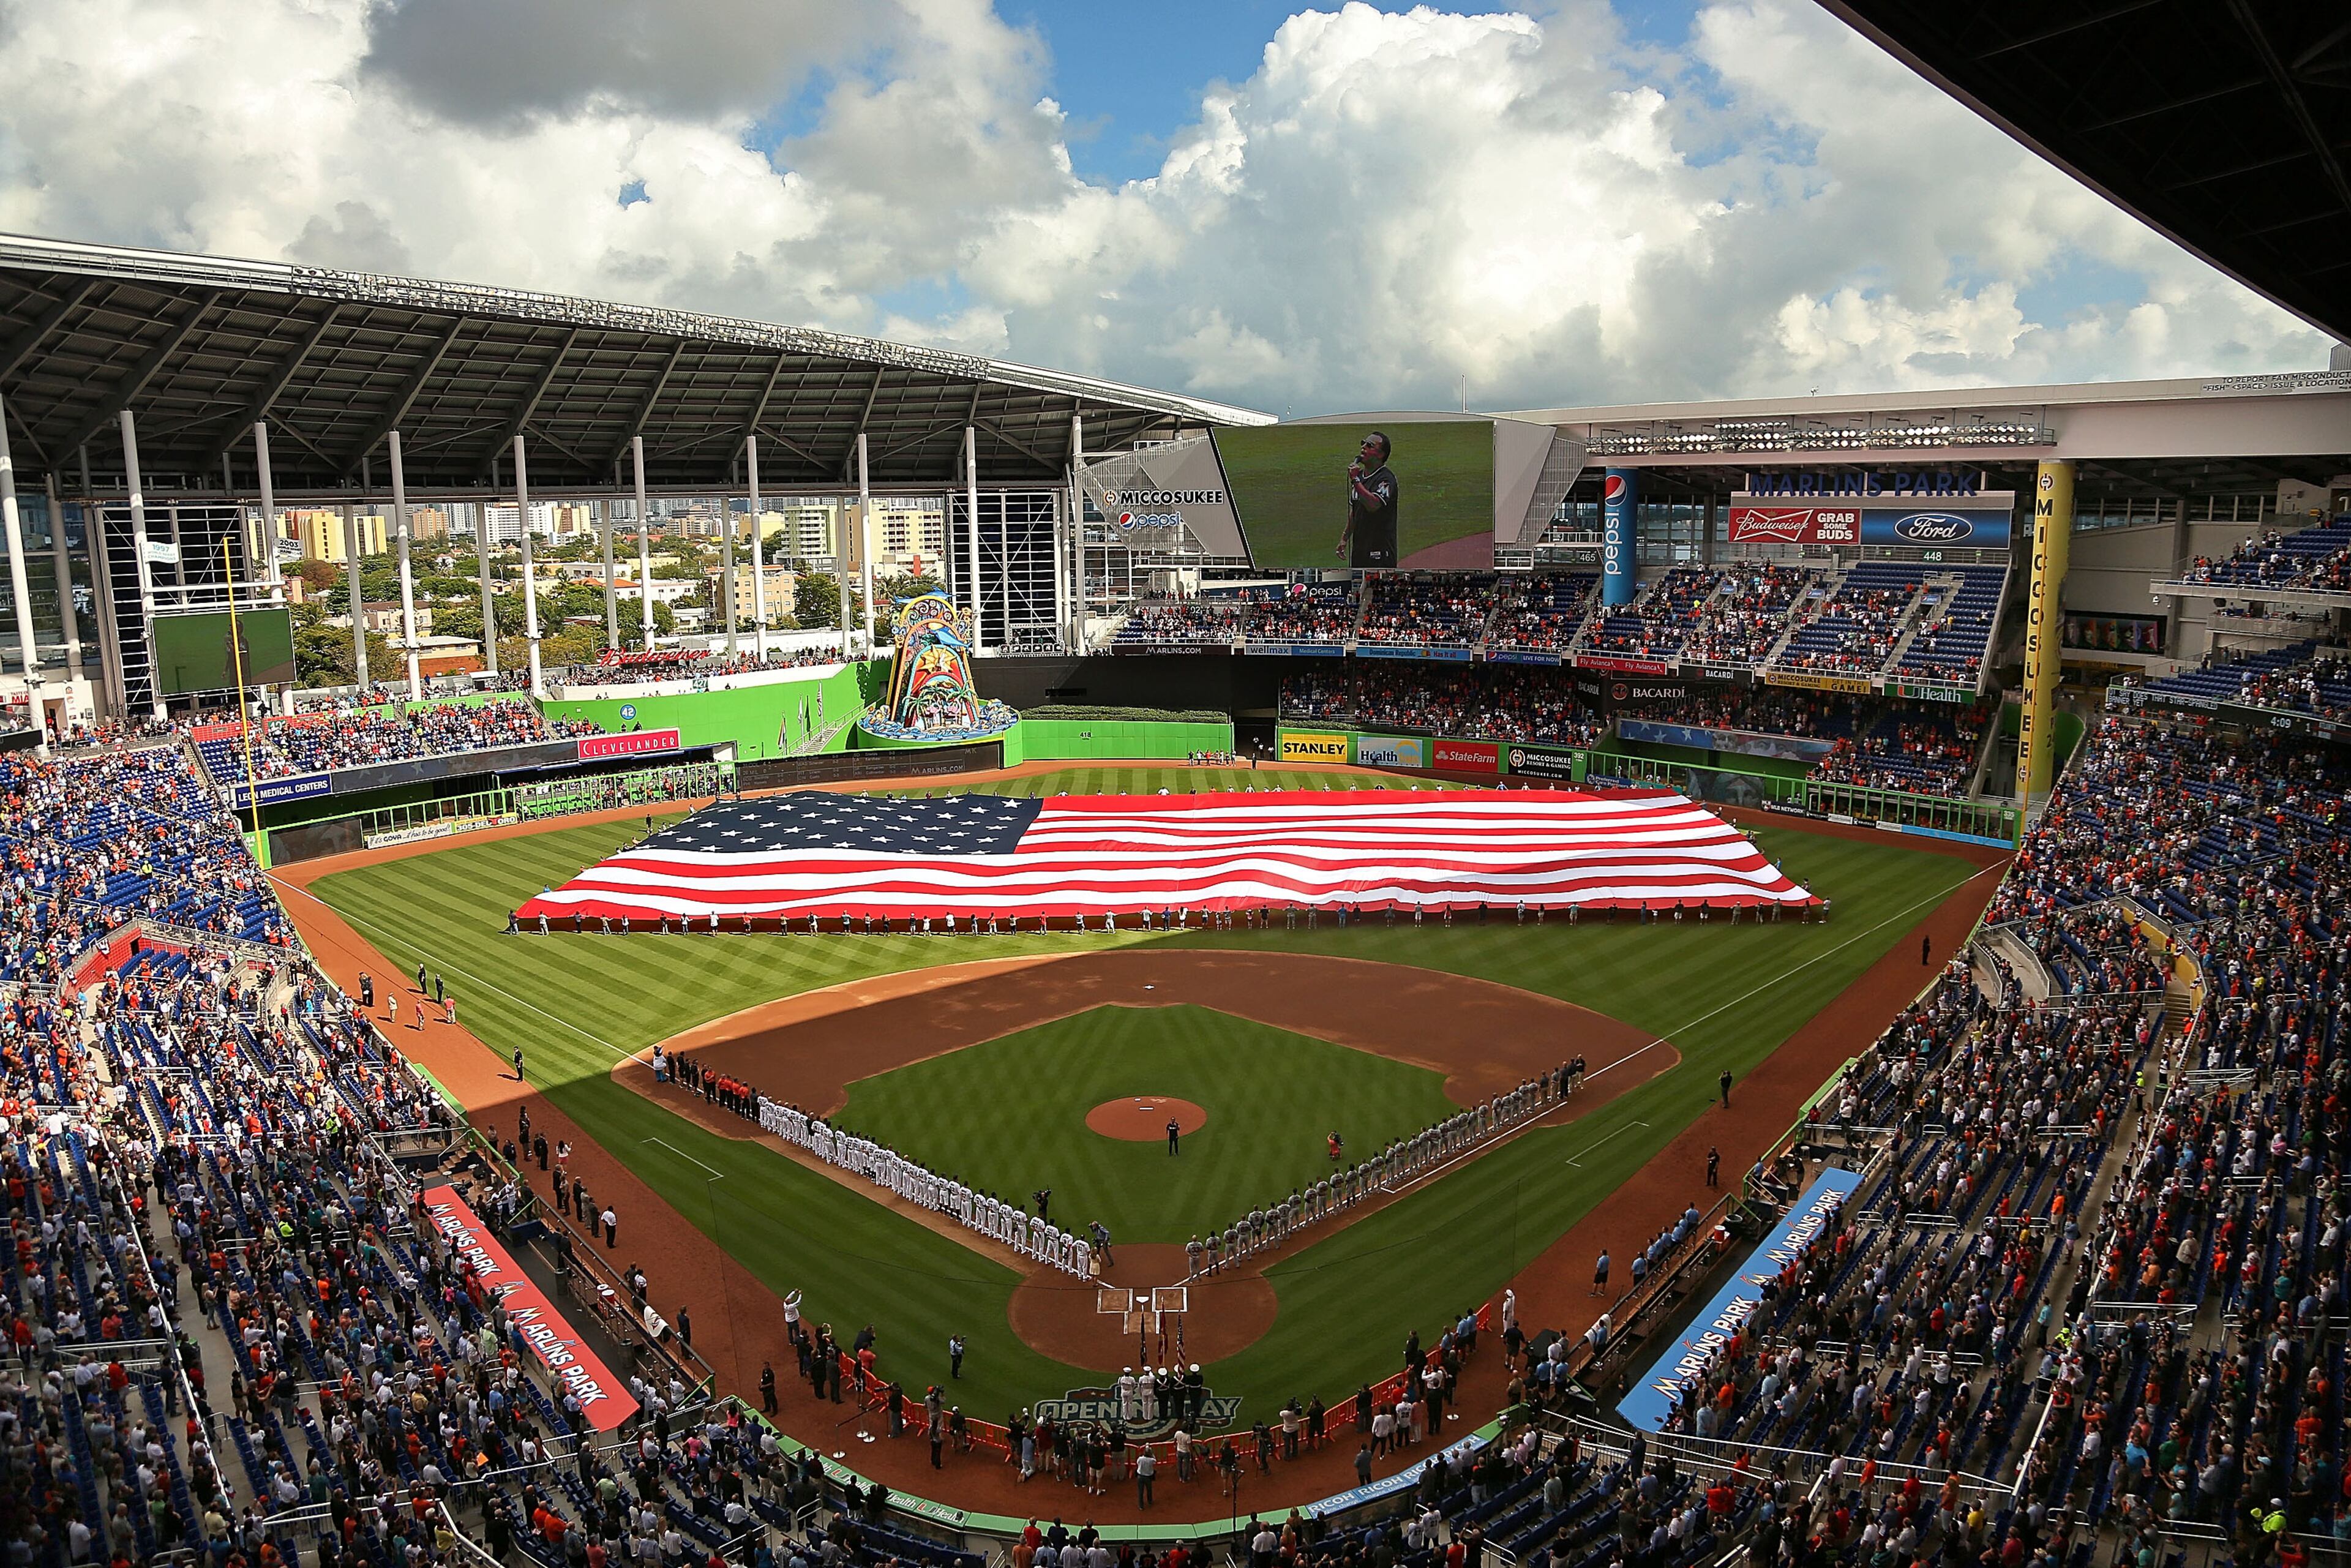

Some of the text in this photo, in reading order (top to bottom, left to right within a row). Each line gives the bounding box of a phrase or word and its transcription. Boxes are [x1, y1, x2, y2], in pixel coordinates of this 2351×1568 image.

[1750, 471, 1978, 497] MARLINS PARK
[1120, 490, 1224, 505] MICCOSUKEE
[1136, 511, 1181, 529] pepsi
[1736, 509, 1809, 531] Budweiser
[1817, 513, 1854, 523] GRAB
[1817, 530, 1853, 540] BUDS
[1908, 517, 1957, 539] Ford
[152, 544, 170, 552] 1997
[279, 539, 298, 548] 2003
[1605, 512, 1622, 575] pepsi
[1580, 553, 1595, 561] 465
[1923, 552, 1942, 561] 448
[1309, 586, 1343, 598] pepsi
[1190, 606, 1201, 614] 02
[2020, 498, 2053, 759] MICCOSUKEE
[594, 646, 711, 667] Budweiser
[1146, 646, 1201, 655] MARLINS.COM
[1250, 645, 1289, 655] wellmax
[1636, 662, 1657, 671] Avianca
[1706, 669, 1734, 680] BACARDÍ
[1777, 674, 1821, 684] MICCOSUKEE
[692, 679, 707, 688] 427
[1578, 681, 1599, 696] BACARDÍ
[1831, 683, 1867, 692] GAME!
[1633, 686, 1685, 698] BACARDÍ
[1898, 686, 1962, 703] UHealth
[2109, 695, 2129, 705] BANNER
[2152, 694, 2166, 703] THAT
[2169, 696, 2218, 710] STAR-SPANGLED
[622, 707, 635, 717] 42
[2271, 716, 2291, 728] 4:09
[583, 737, 676, 756] CLEVELANDER
[1283, 742, 1345, 755] STANLEY
[1526, 753, 1572, 764] MICCOSUKEE
[911, 765, 963, 775] MARLINS.COM
[1518, 769, 1562, 778] MICCOSUKEE.COM
[238, 780, 328, 802] LEON MEDICAL CENTERS
[383, 834, 402, 842] GOYA
[1809, 1187, 1846, 1215] PARK
[430, 1201, 477, 1248] MARLINS
[1763, 1214, 1823, 1265] MARLINS
[463, 1245, 501, 1278] PARK
[1712, 1294, 1757, 1330] PARK
[508, 1305, 576, 1366] MARLINS
[1649, 1331, 1725, 1401] MARLINS
[561, 1364, 610, 1407] PARK
[1039, 1401, 1171, 1419] OPENNG
[1358, 1477, 1403, 1495] RICOH
[1308, 1493, 1355, 1513] RICOH
